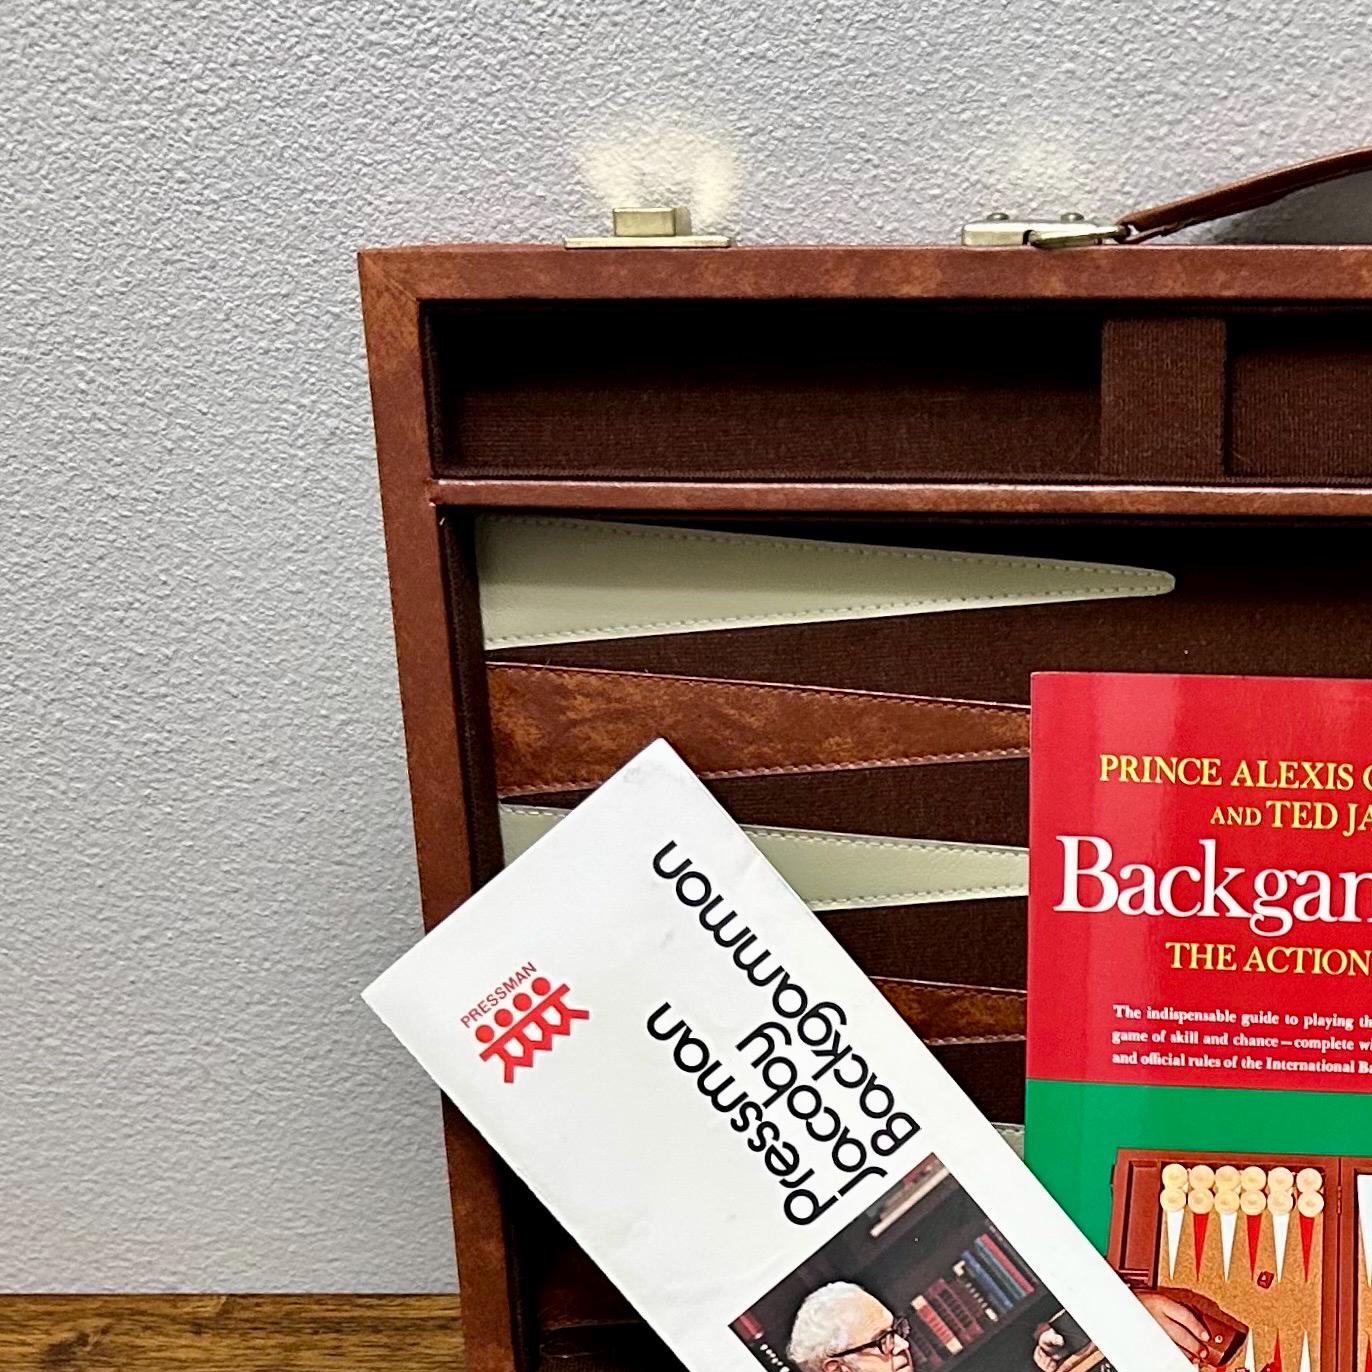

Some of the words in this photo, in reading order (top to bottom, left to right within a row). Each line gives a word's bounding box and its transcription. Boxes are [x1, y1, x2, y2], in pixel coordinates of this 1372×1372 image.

[1099, 754, 1222, 787] PRINCE
[1231, 760, 1354, 792] ALEXIS
[1210, 806, 1262, 827] AND
[1266, 800, 1339, 830] TED
[1165, 942, 1237, 971] THE
[1244, 945, 1372, 977] ACTION
[460, 961, 537, 1028] PRESSMAN
[653, 840, 921, 1157] Backgammon
[1113, 1004, 1142, 1019] The
[1146, 1006, 1237, 1025] indispensable
[1240, 1012, 1279, 1027] guide
[1284, 1014, 1299, 1026] to
[1304, 1012, 1354, 1031] playing
[1111, 1030, 1148, 1045] game
[1151, 1029, 1167, 1043] of
[1170, 1030, 1199, 1045] skill
[1202, 1032, 1229, 1046] and
[1111, 1051, 1138, 1065] and
[1140, 1052, 1185, 1067] official
[1188, 1053, 1221, 1068] rules
[1223, 1055, 1239, 1069] of
[1241, 1056, 1263, 1070] the
[1266, 1056, 1355, 1074] International
[646, 1002, 838, 1226] Pressman
[735, 1021, 888, 1197] Jacoby
